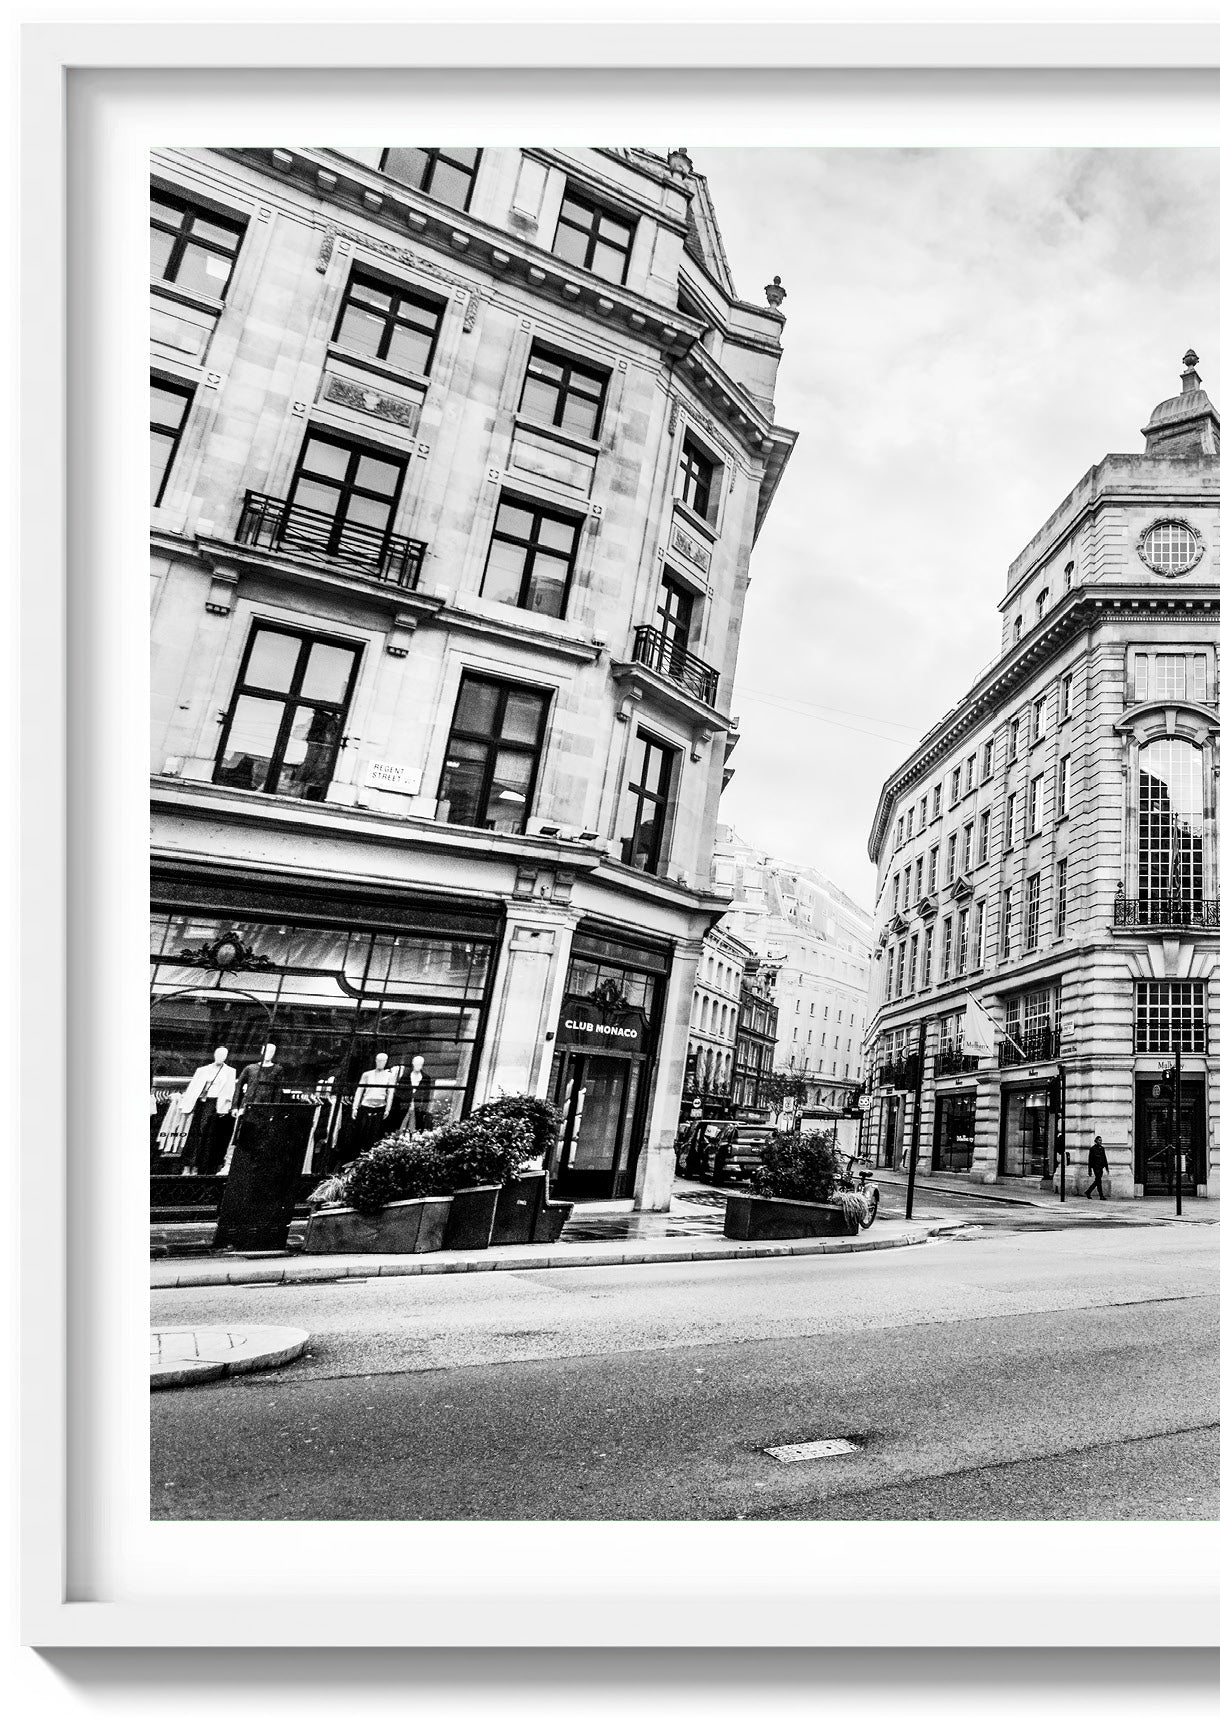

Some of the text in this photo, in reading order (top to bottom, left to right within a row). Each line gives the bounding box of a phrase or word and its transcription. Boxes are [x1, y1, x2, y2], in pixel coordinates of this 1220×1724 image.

[374, 763, 404, 774] REGENT
[372, 772, 401, 782] STREET
[565, 1020, 638, 1038] CLUB MONACO
